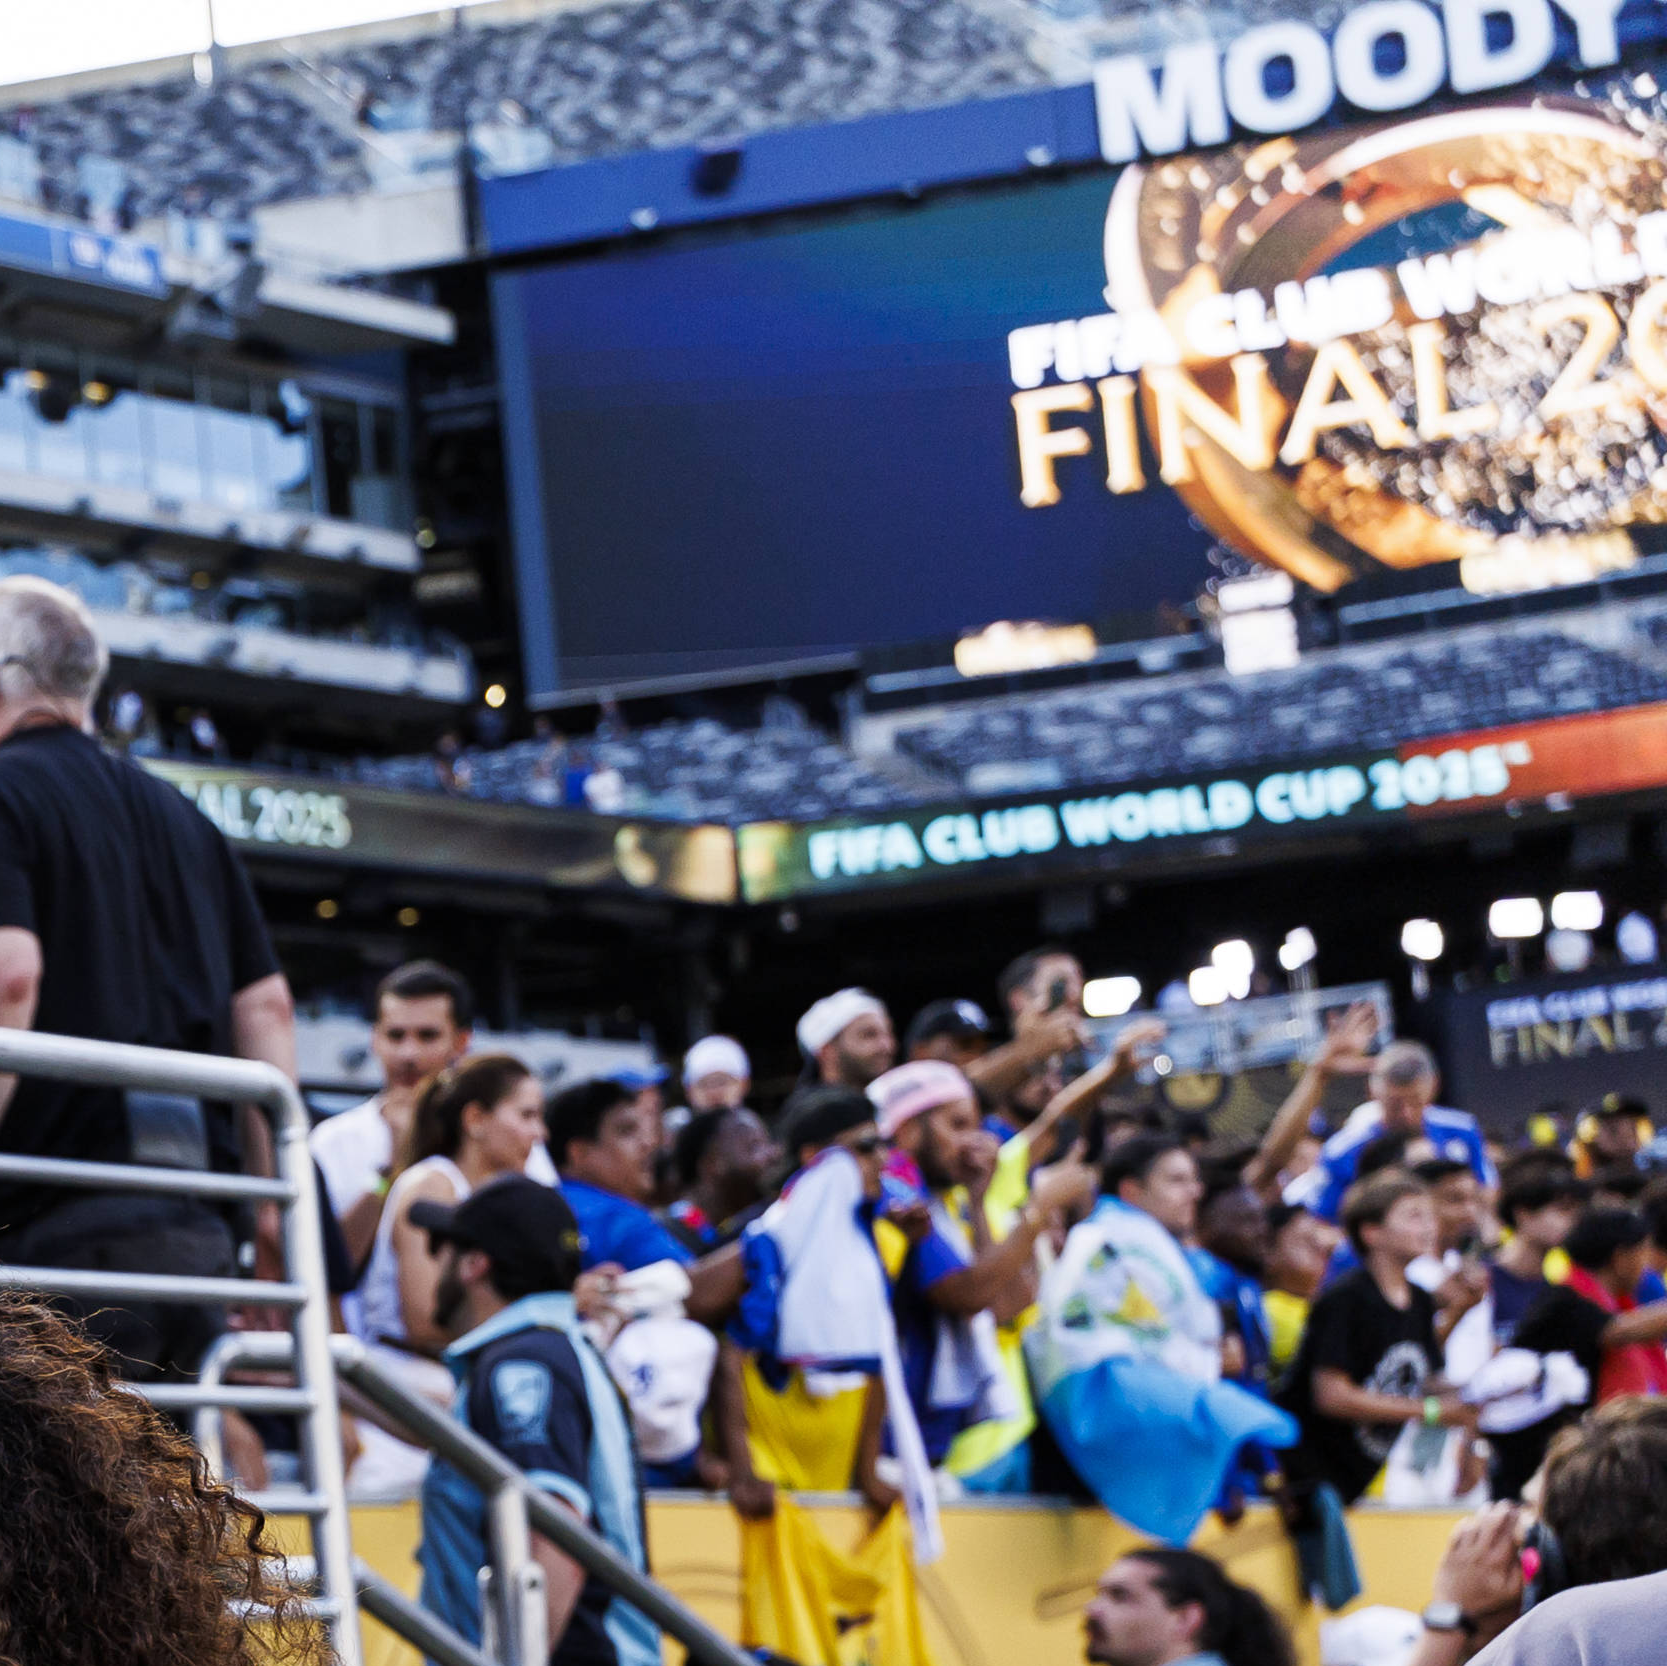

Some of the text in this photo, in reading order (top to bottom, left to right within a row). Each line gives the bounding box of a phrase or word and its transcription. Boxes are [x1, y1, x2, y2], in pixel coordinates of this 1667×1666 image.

[1184, 267, 1393, 358] CLUB
[1010, 317, 1500, 508] FINAL
[249, 786, 353, 849] 2025
[808, 821, 925, 880] FIFA
[923, 804, 1060, 866] CLUB
[1060, 779, 1255, 848] WORLD
[1255, 764, 1367, 824] CUP
